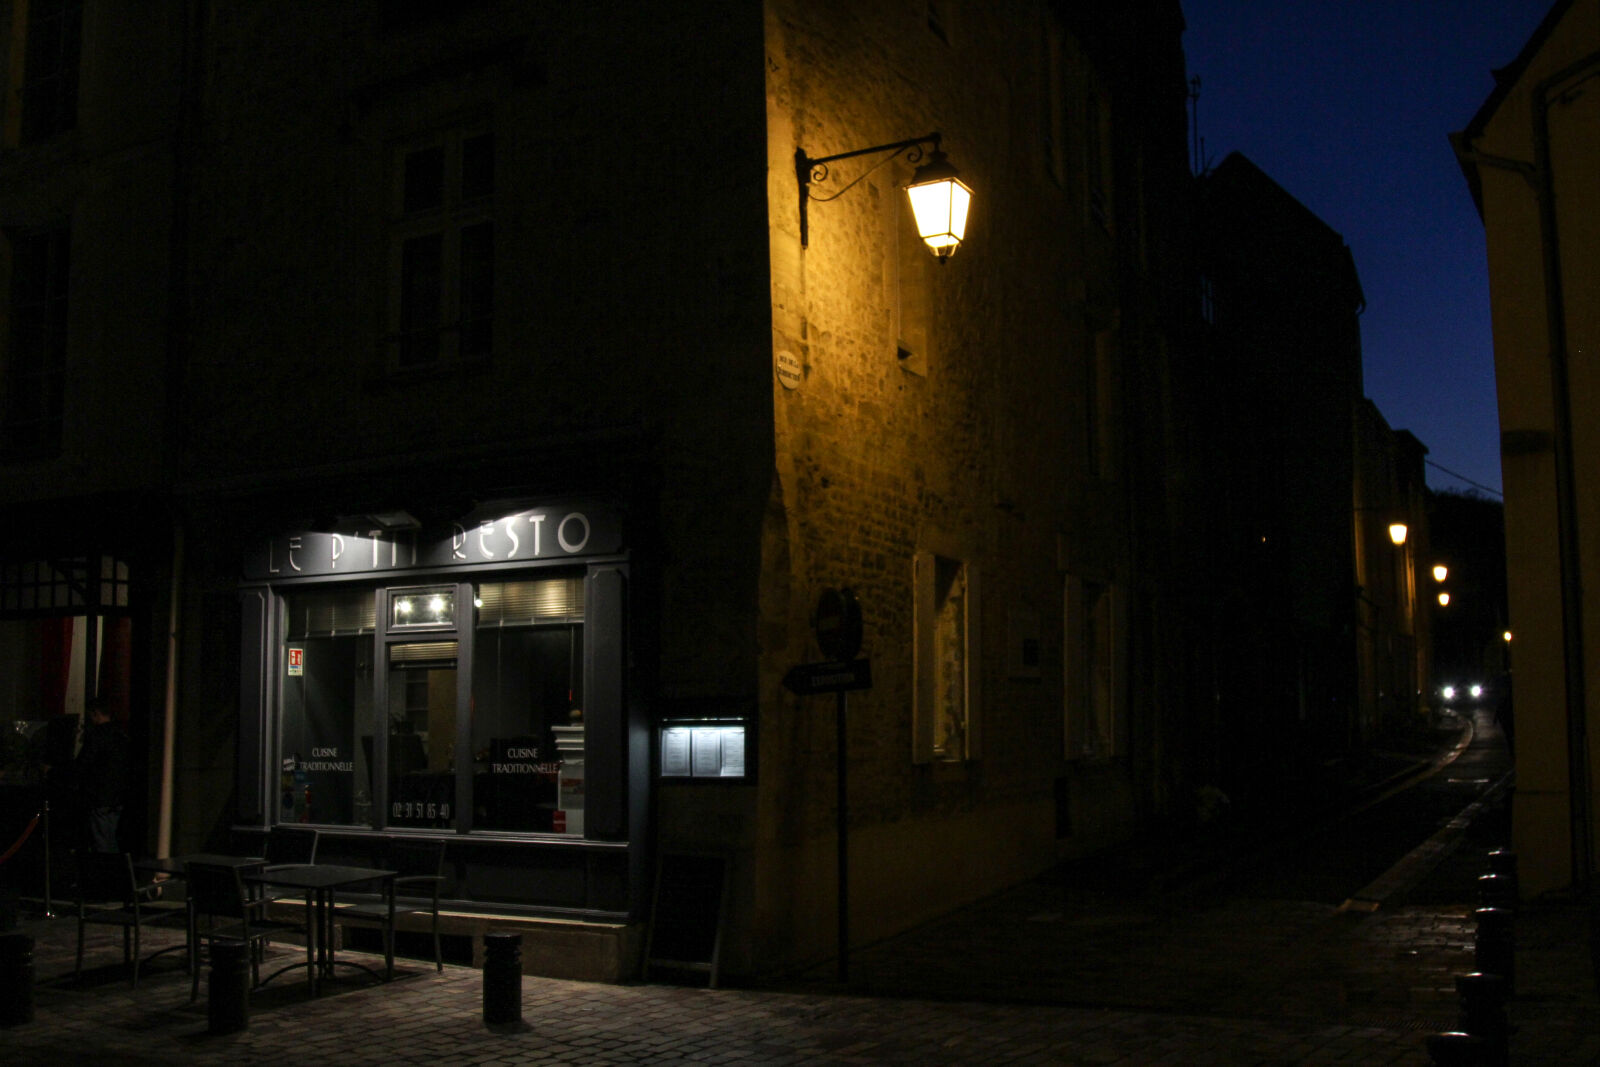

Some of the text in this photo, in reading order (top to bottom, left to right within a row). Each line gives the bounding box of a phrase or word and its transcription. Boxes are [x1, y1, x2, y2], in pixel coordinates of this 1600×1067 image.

[269, 536, 302, 573] LE
[453, 512, 590, 560] RESTO
[312, 747, 337, 758] CUISINE
[507, 747, 539, 759] CUISINE
[299, 761, 353, 772] TRADITIONNELLE
[492, 762, 558, 774] TRADITIONNELLE
